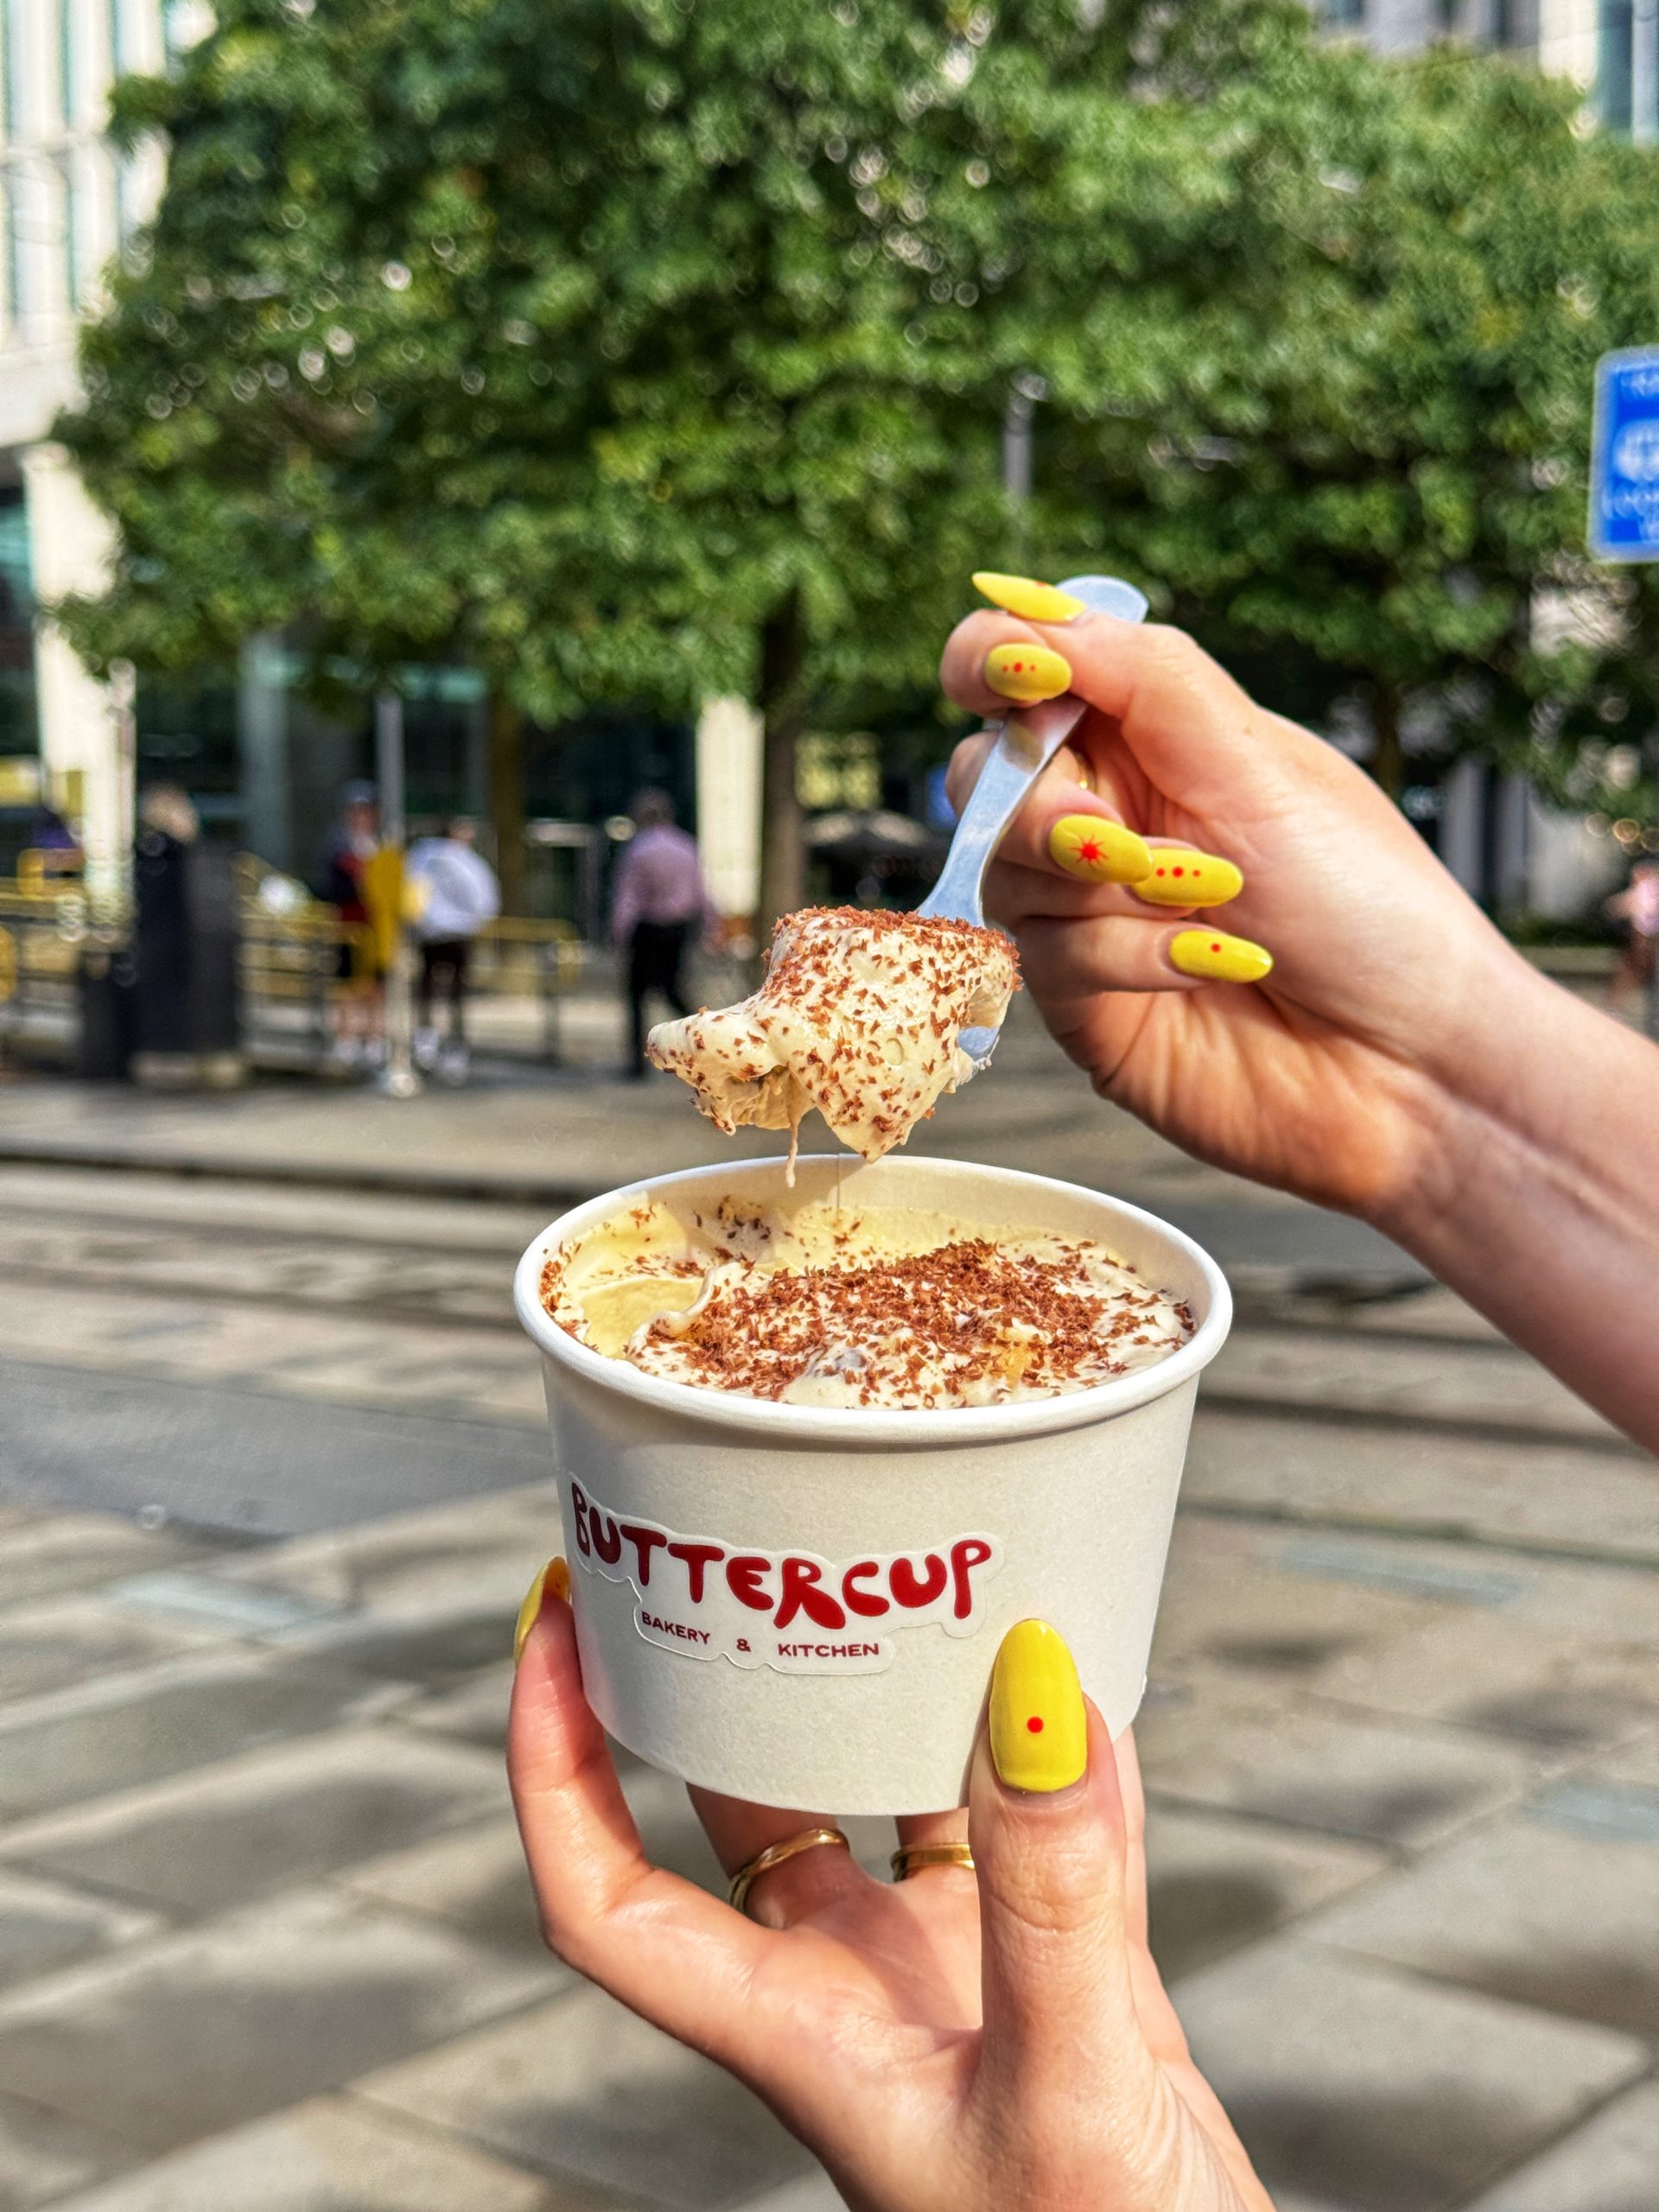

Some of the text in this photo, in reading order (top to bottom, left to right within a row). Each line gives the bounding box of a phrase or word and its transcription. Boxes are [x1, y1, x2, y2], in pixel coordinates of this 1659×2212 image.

[571, 1481, 992, 1630] BUTTERCUP
[641, 1611, 879, 1658] BAKERY & KITCHEN
